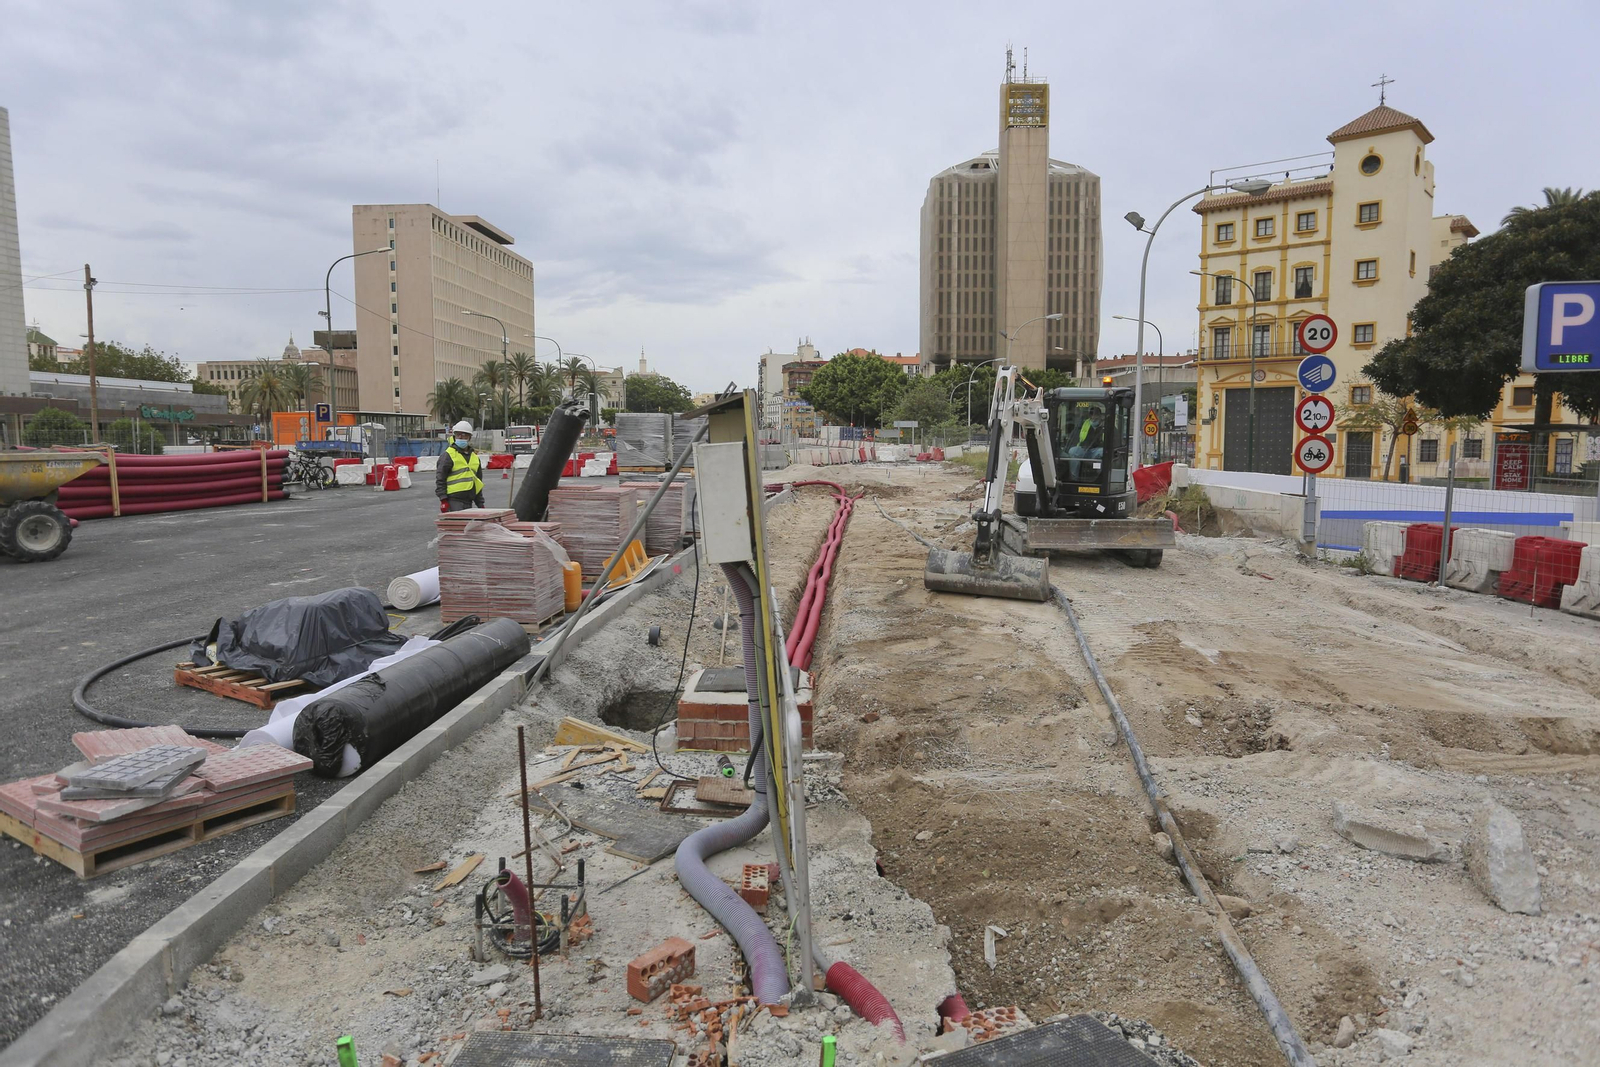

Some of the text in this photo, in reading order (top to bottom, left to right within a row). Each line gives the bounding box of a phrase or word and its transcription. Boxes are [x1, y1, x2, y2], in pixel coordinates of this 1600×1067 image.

[1550, 293, 1595, 346] P
[1308, 327, 1330, 340] 20
[1559, 355, 1589, 363] LIBRE
[319, 406, 328, 418] P
[1118, 501, 1126, 511] E50
